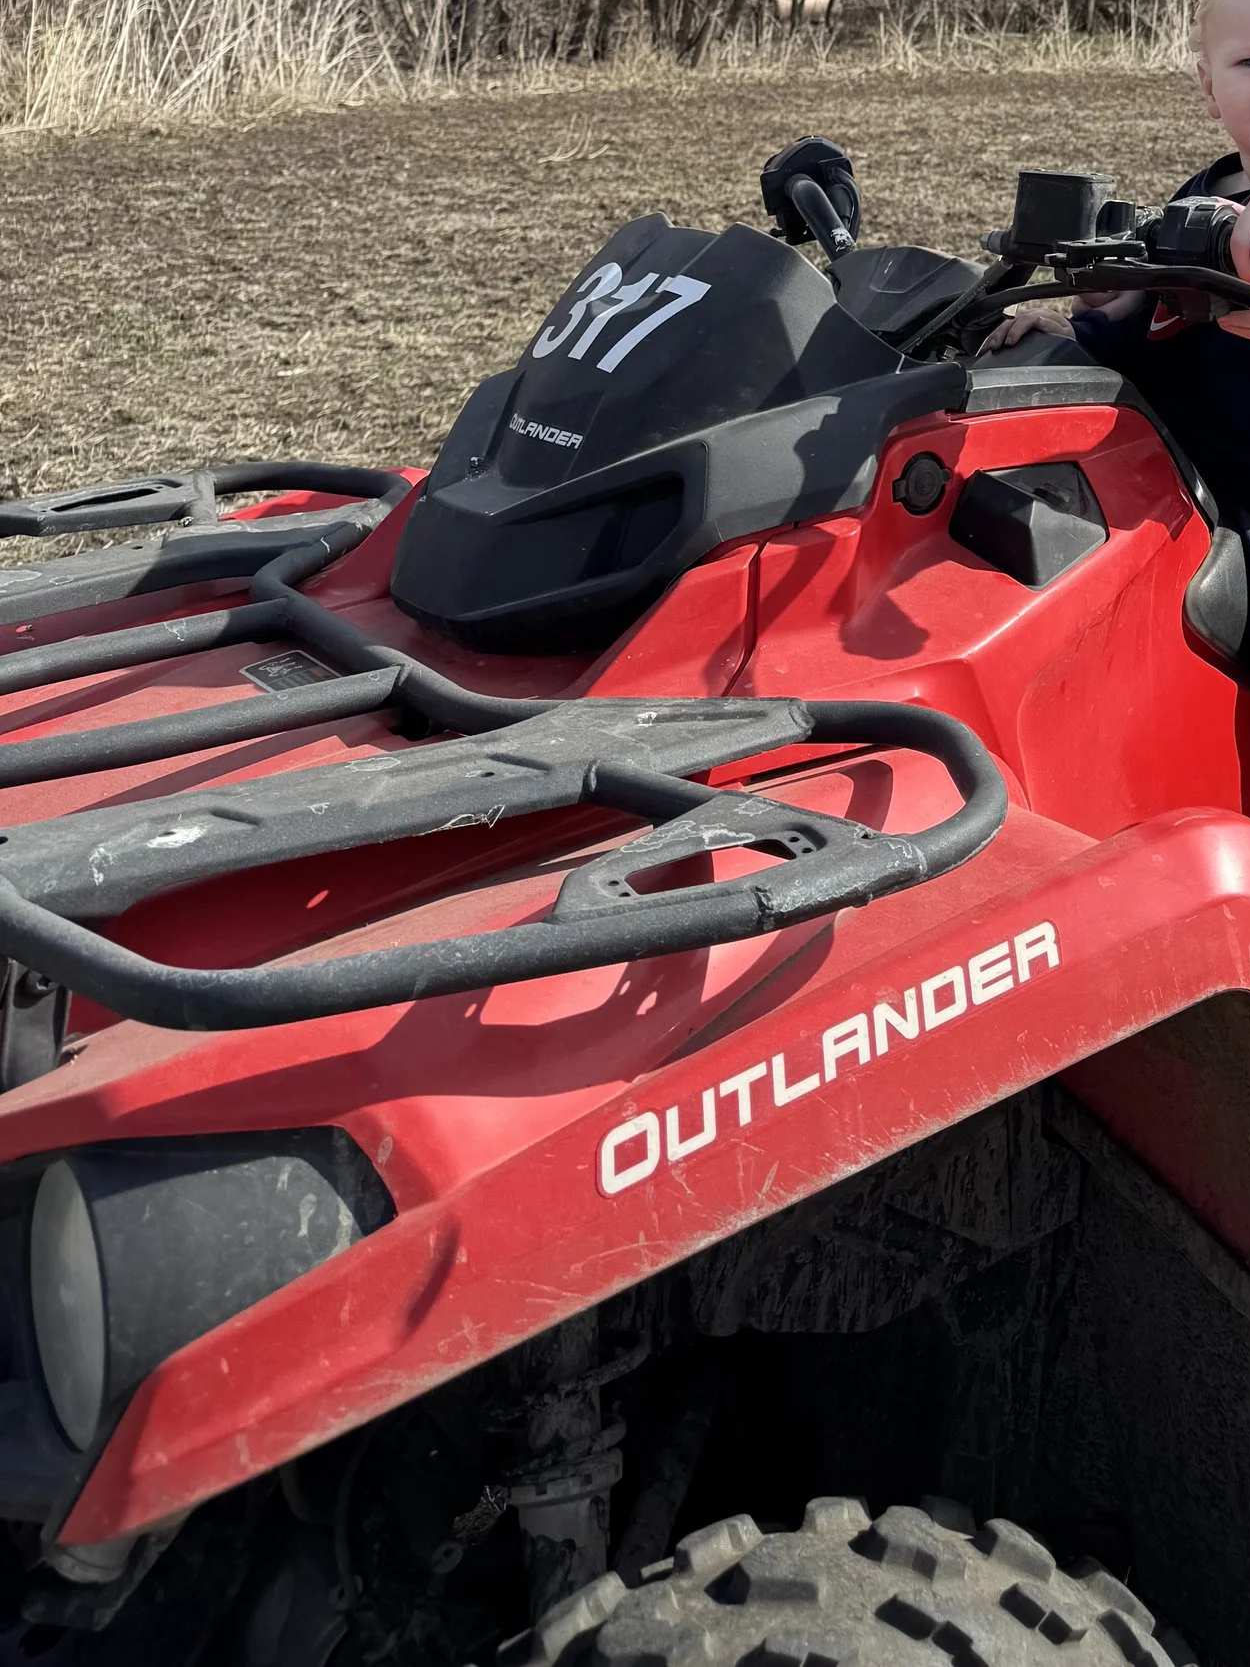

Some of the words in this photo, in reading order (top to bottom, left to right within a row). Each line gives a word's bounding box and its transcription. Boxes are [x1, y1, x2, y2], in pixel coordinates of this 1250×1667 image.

[532, 262, 712, 373] 317
[509, 413, 583, 449] OUTLANDER
[600, 921, 1061, 1196] OUTLANDER
